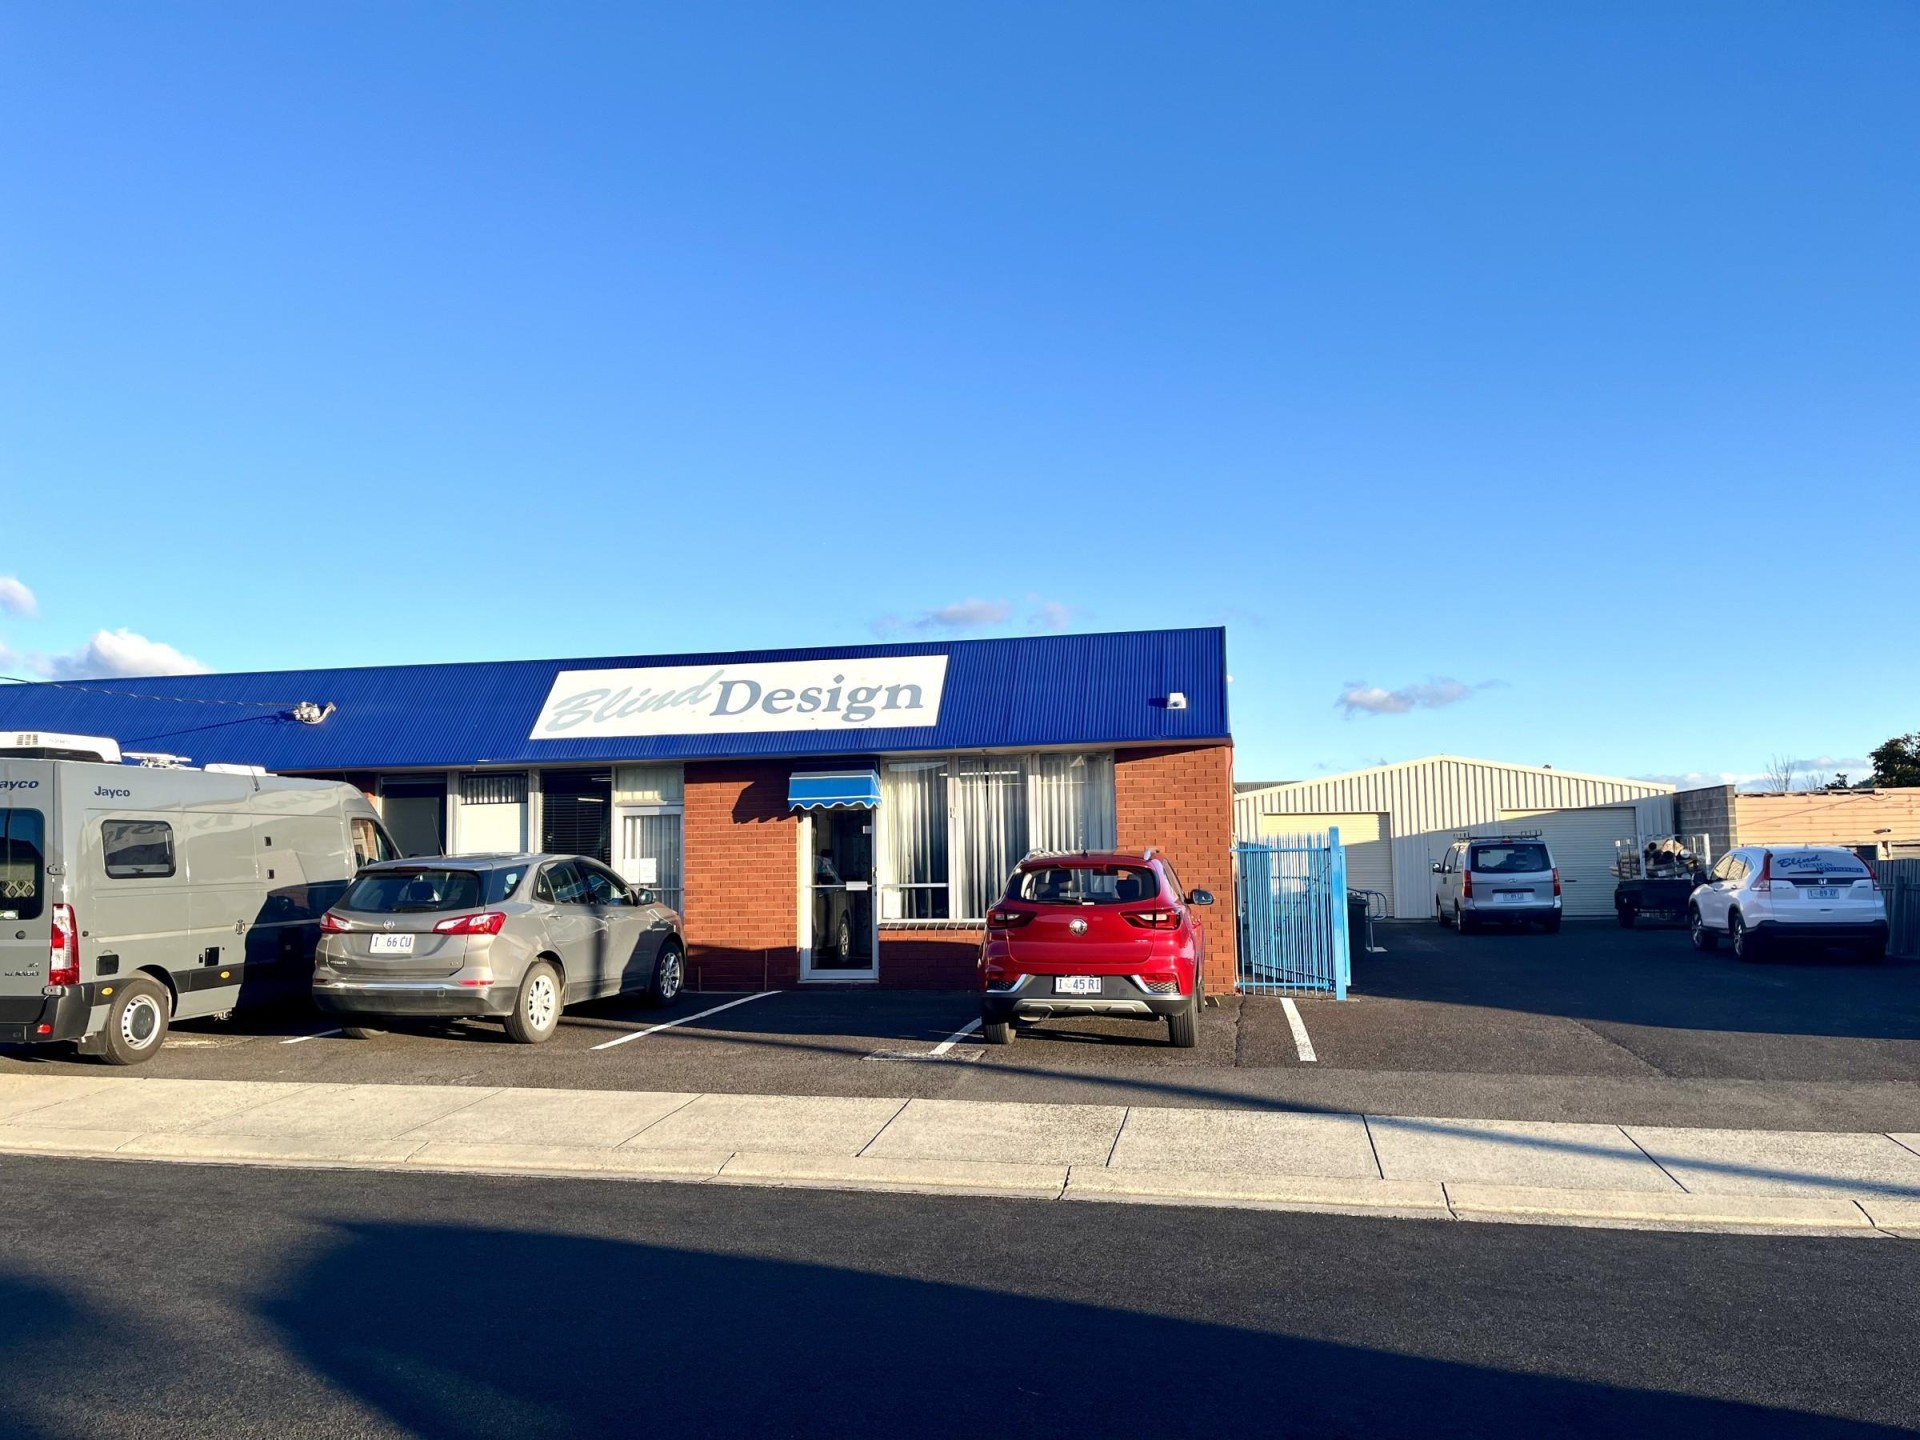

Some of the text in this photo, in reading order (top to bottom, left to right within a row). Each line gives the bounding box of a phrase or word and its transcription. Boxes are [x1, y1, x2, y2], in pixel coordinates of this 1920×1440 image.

[546, 669, 923, 731] Blind Design
[0, 780, 39, 791] ayco
[94, 786, 131, 797] Jayco
[386, 936, 398, 948] 66
[399, 936, 412, 948] CU
[1072, 978, 1085, 990] 45
[1088, 978, 1100, 990] RI
